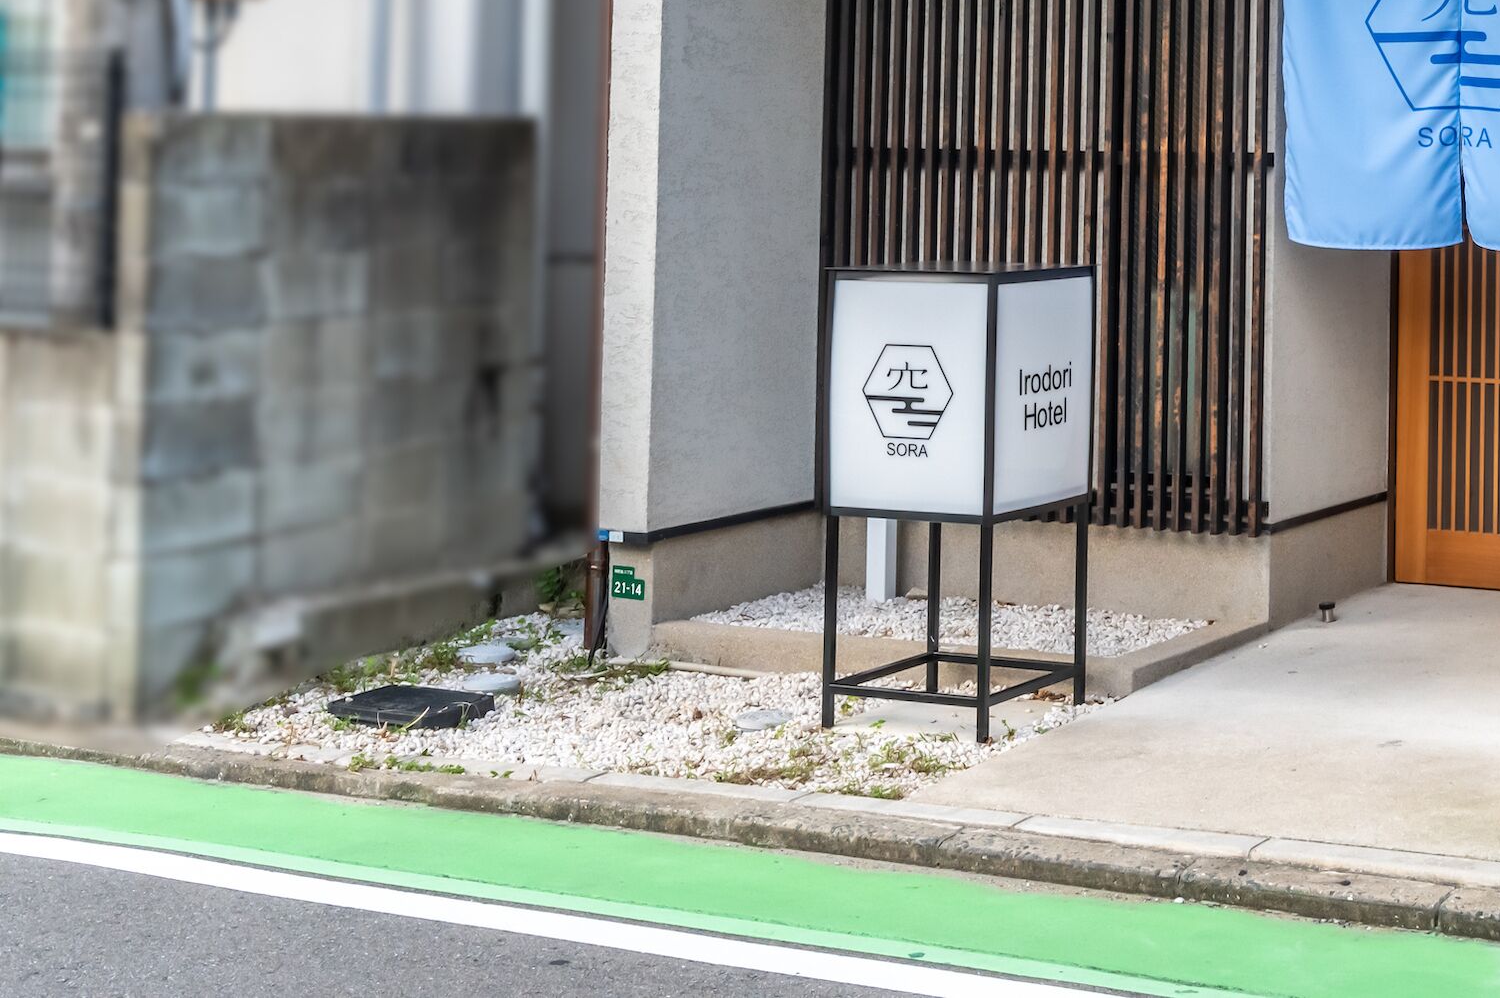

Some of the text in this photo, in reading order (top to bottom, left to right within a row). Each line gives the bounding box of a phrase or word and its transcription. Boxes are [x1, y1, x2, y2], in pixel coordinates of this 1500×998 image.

[1418, 125, 1492, 148] SORA
[1019, 361, 1072, 396] Irodori
[1024, 397, 1067, 431] Hotel
[886, 442, 928, 458] SORA
[614, 581, 641, 595] 21-14
